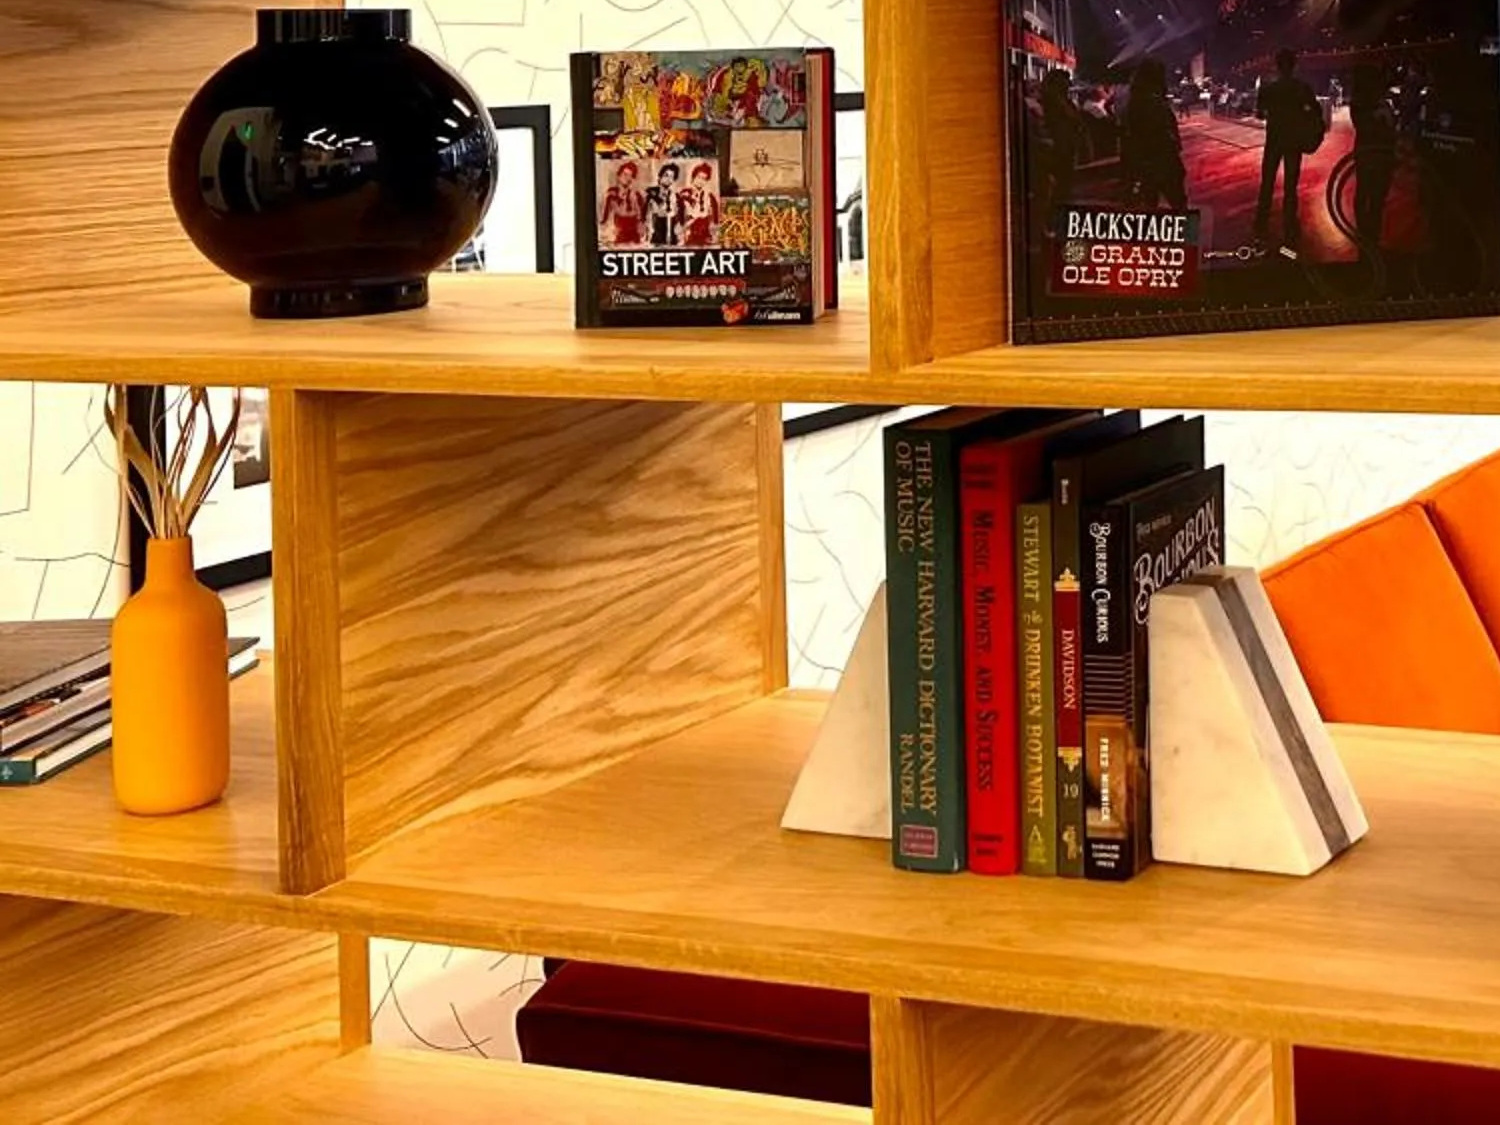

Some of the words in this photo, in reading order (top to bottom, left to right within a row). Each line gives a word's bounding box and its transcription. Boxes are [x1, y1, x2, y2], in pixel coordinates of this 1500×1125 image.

[602, 252, 695, 276] STREET
[701, 251, 749, 275] ART
[1067, 211, 1187, 242] BACKSTAGE
[1090, 244, 1185, 266] GRAND
[1063, 266, 1111, 285] OLE
[1117, 268, 1184, 288] OPRY
[895, 441, 913, 472] OF
[915, 441, 932, 490] THE
[896, 478, 915, 553] MUSIC
[917, 498, 935, 554] NEW
[1023, 515, 1040, 603] STEWART
[917, 560, 936, 671] HARVARD
[1025, 629, 1042, 716] DRUNKEN
[1062, 629, 1077, 710] DAVIDSON
[900, 733, 916, 814] RANDEL
[918, 680, 937, 816] DICTIONARY
[1026, 724, 1044, 818] BOTANIST
